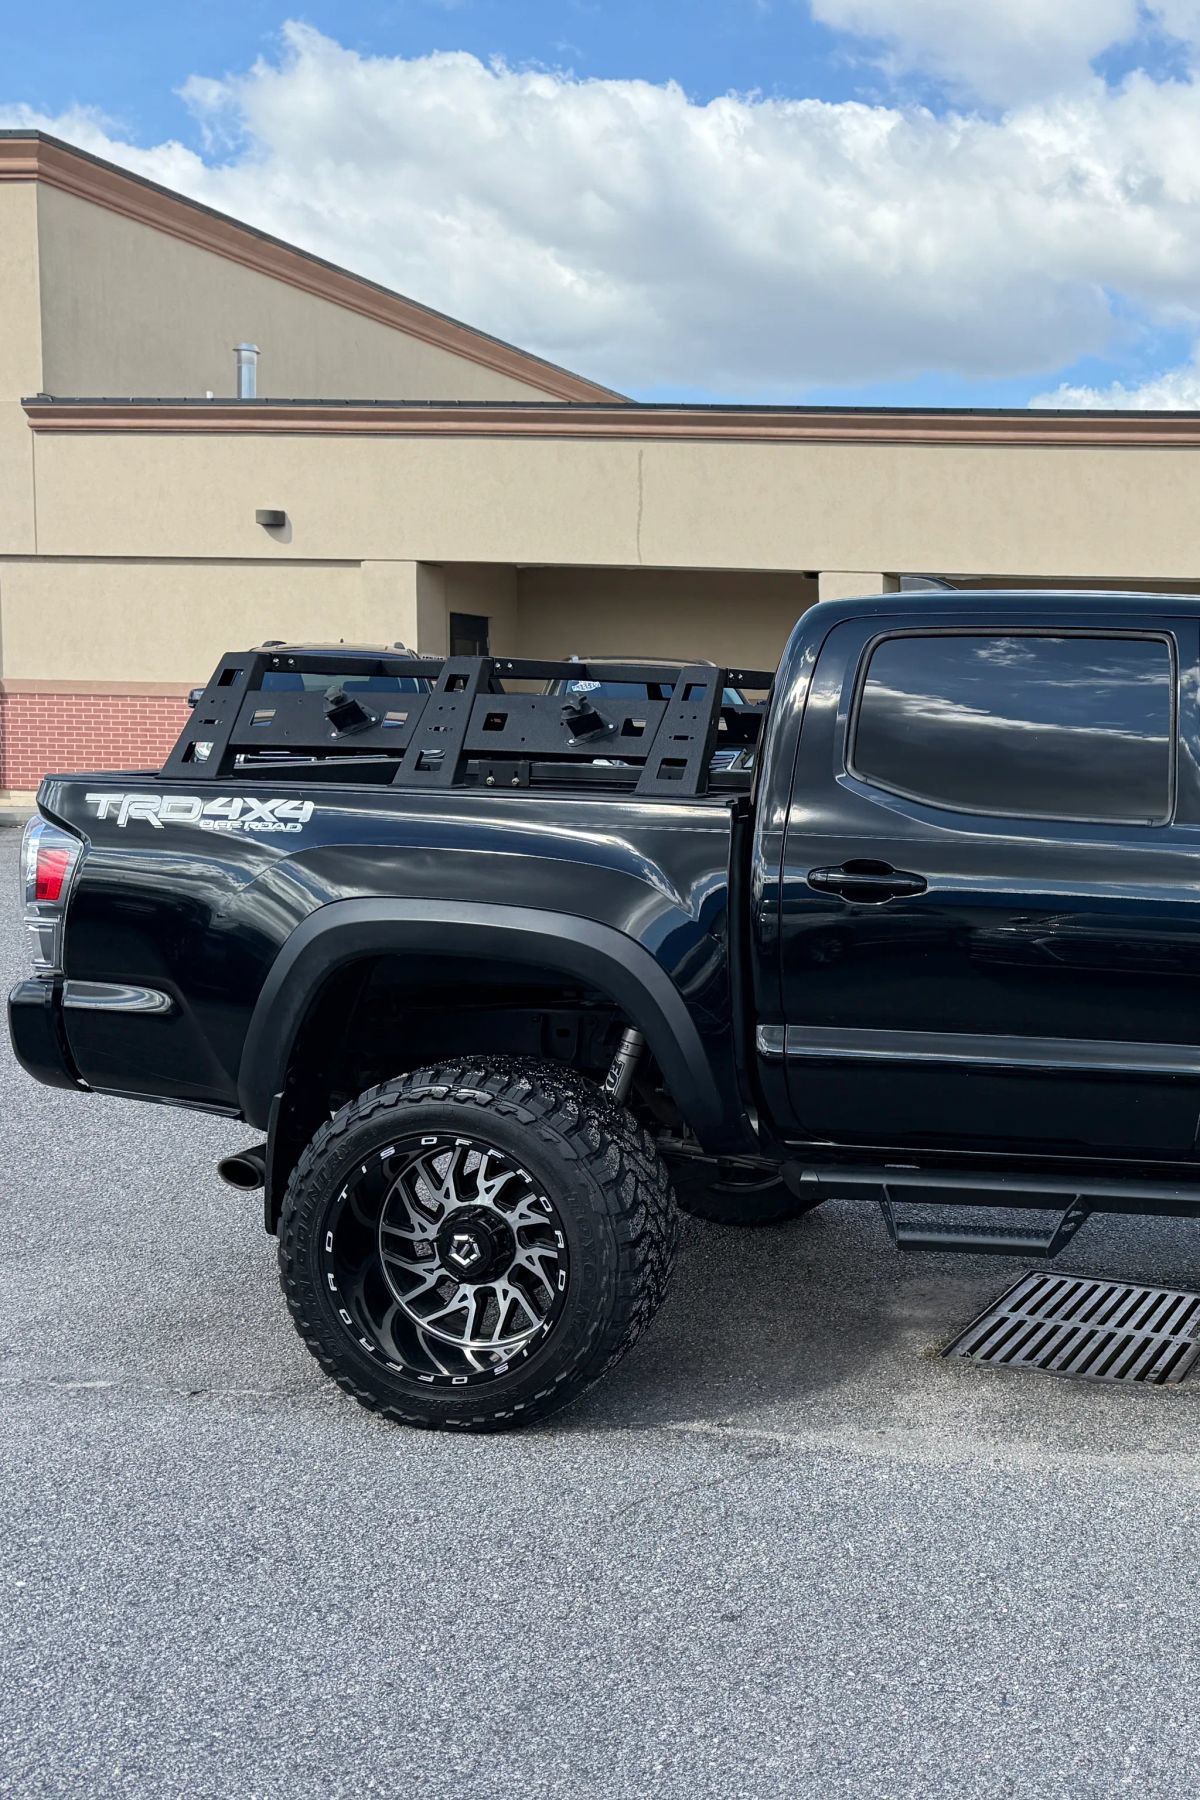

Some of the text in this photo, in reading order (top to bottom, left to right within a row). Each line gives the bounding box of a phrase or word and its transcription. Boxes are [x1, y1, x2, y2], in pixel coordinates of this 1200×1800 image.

[85, 793, 203, 828] TRD
[200, 820, 303, 833] OFF ROAD
